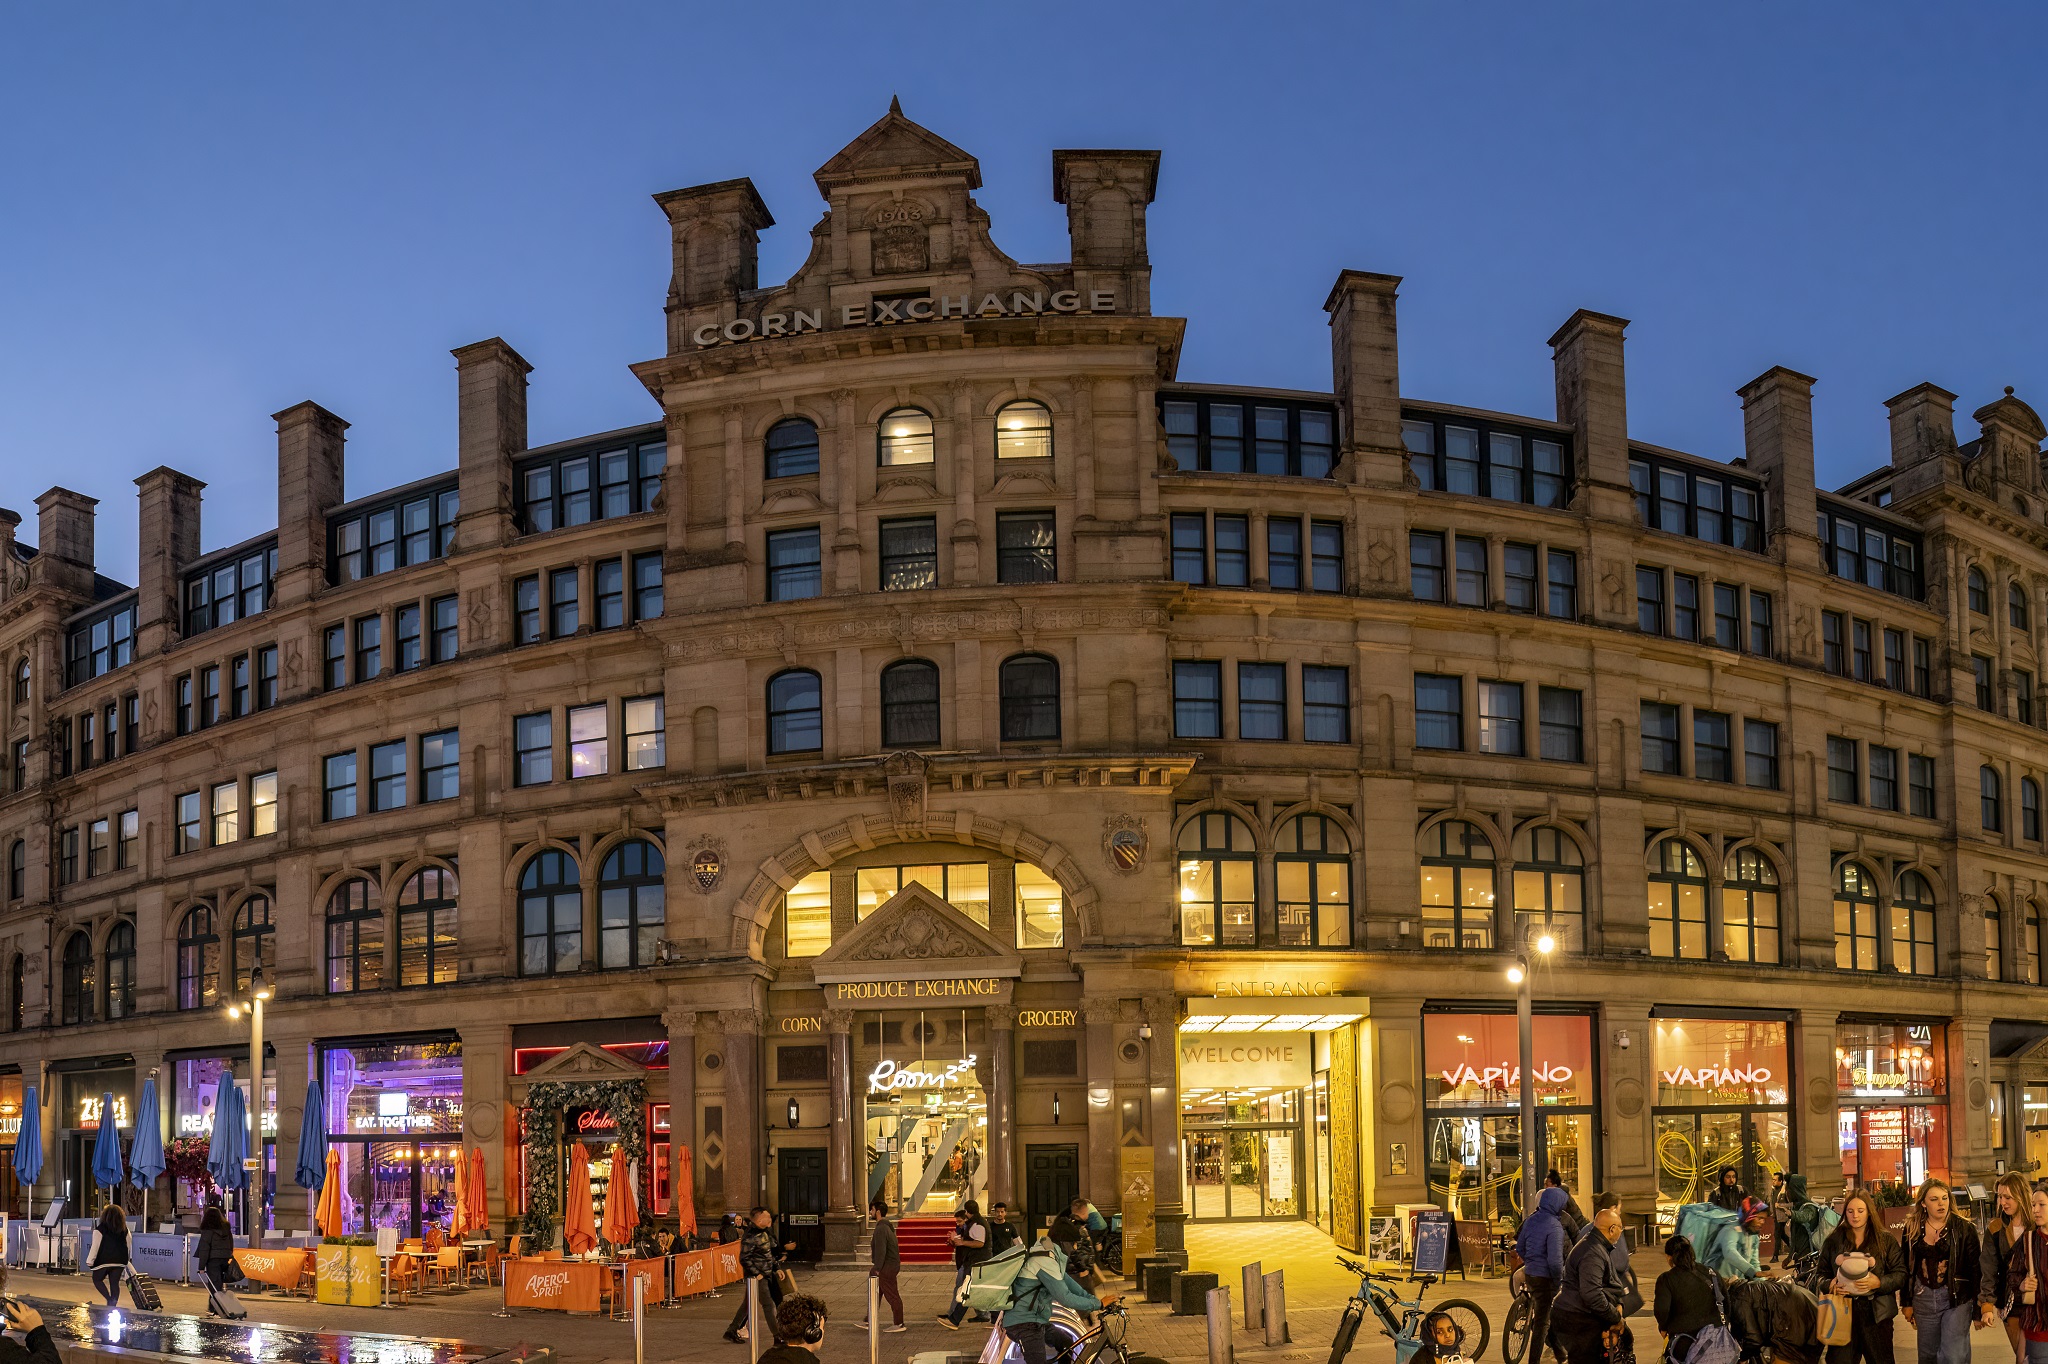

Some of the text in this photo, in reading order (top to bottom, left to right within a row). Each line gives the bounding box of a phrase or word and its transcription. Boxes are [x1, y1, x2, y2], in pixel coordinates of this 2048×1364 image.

[877, 206, 922, 222] 1903
[693, 289, 1116, 346] CORN EXCHANGE
[838, 979, 1000, 999] PRODUCE EXCHANGE
[1214, 981, 1343, 996] ENTRANCE
[782, 1017, 822, 1032] CORN
[1018, 1011, 1078, 1027] GROCERY
[1182, 1045, 1294, 1064] WELCOME
[1442, 1061, 1573, 1088] VAPIANO
[1663, 1062, 1772, 1088] VAPIANO
[355, 1115, 434, 1131] EAT. TOGETHER.
[139, 1247, 173, 1257] THE REAL GREEK
[684, 1259, 703, 1280] APEROL
[526, 1271, 570, 1290] APEROL
[532, 1285, 563, 1298] SPRITZ
